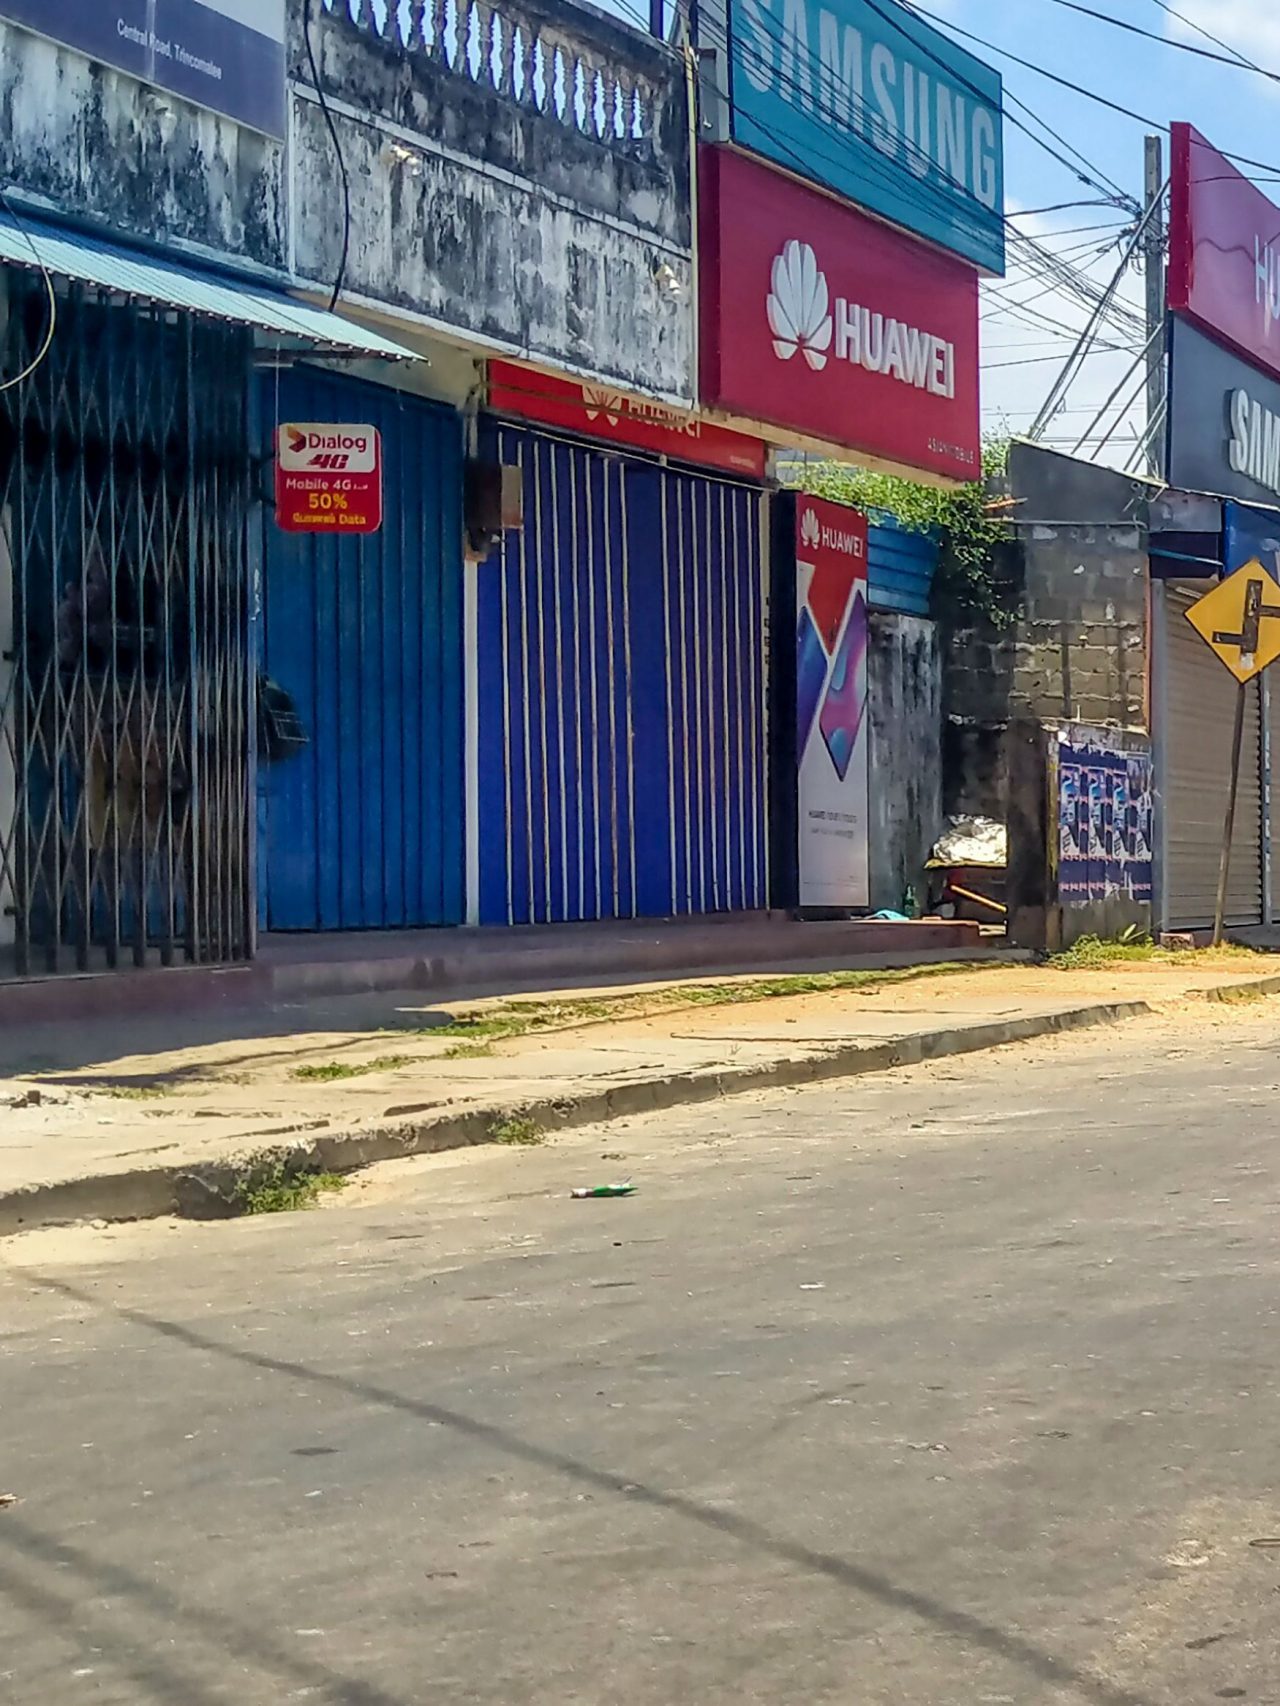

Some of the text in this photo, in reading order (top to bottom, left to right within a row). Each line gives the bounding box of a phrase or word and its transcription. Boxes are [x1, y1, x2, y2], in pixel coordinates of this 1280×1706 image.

[740, 0, 997, 210] SAMSUNG
[834, 298, 955, 400] HUAWEI
[308, 432, 367, 453] Dialog
[307, 453, 350, 469] 4G
[286, 478, 329, 490] Mobile
[333, 479, 352, 490] 4G
[308, 492, 348, 509] 50%
[821, 525, 864, 558] HUAWEI
